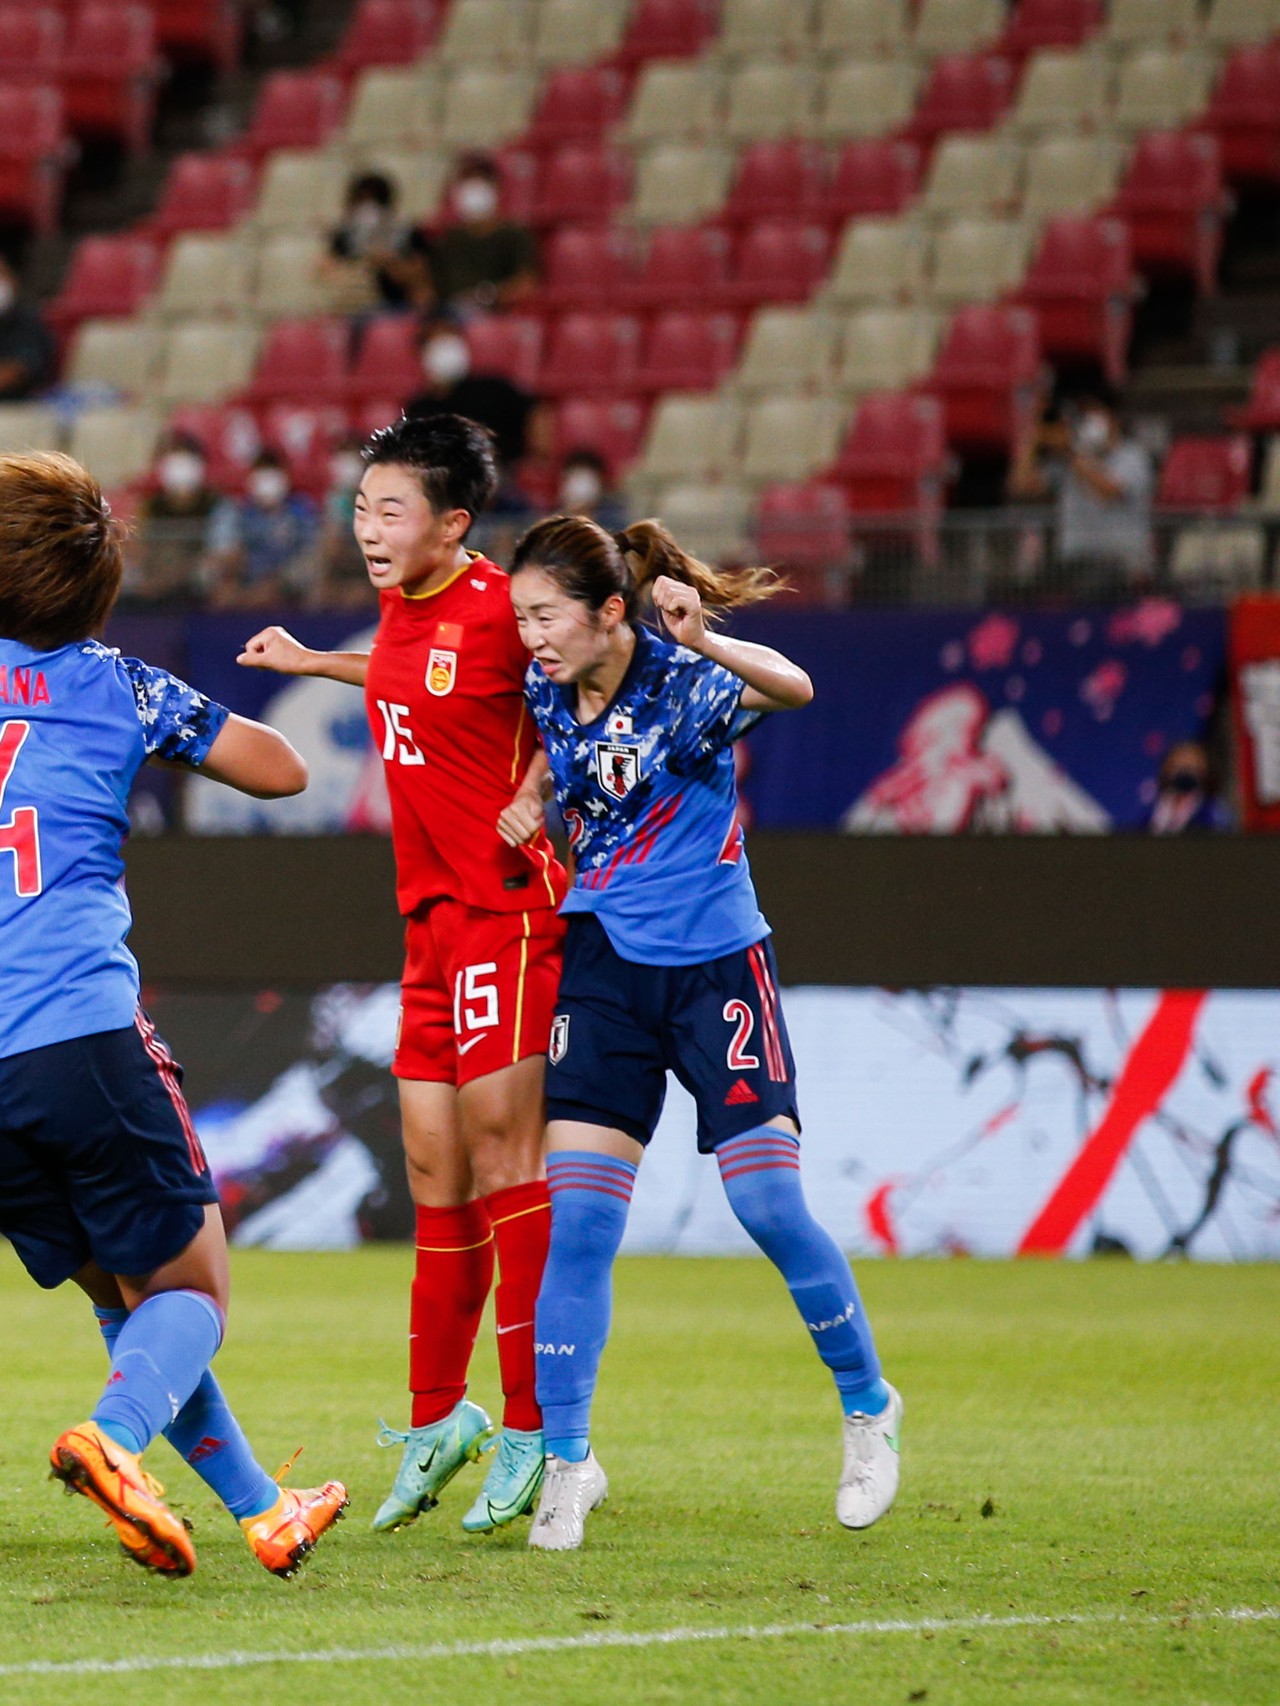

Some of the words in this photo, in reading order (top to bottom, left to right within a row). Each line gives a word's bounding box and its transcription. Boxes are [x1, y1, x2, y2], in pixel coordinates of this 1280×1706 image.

[376, 699, 426, 766] 15
[454, 961, 499, 1034] 15
[723, 999, 760, 1070] 2
